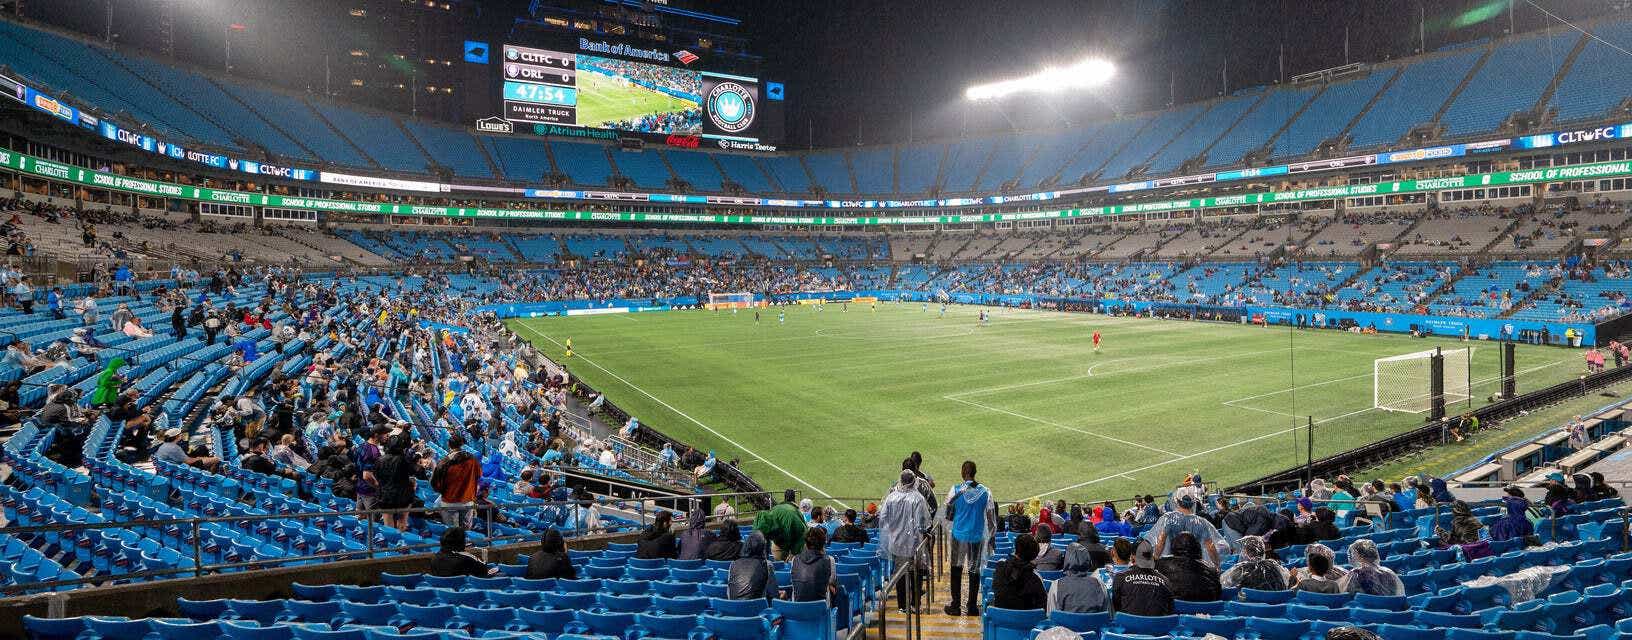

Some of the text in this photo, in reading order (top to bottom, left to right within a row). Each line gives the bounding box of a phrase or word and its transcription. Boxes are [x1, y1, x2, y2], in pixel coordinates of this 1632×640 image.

[579, 38, 670, 61] Bank of America
[521, 52, 569, 66] CLTFC 0
[521, 68, 569, 82] ORL 0
[516, 84, 565, 102] 47:54
[712, 83, 749, 100] CHARLOTTE
[513, 106, 570, 116] DAIMLER TRUCK
[549, 126, 620, 140] Atrium Health
[731, 141, 754, 150] Harris
[36, 164, 69, 178] CHARLOTTE
[1509, 163, 1631, 182] SCHOOL OF PROFESSIONAL
[94, 174, 182, 196] SCHOOL OF PROFESSIONAL STUDIES
[1274, 192, 1296, 200] SCHOOL
[1306, 187, 1349, 198] PROFESSIONAL
[1350, 184, 1377, 193] STUDIES
[1416, 180, 1464, 190] CHARLOTTE
[212, 194, 250, 204] CHARLOTTE
[282, 198, 305, 208] SCHOOL
[306, 200, 314, 208] OF
[314, 200, 356, 211] PROFESSIONAL
